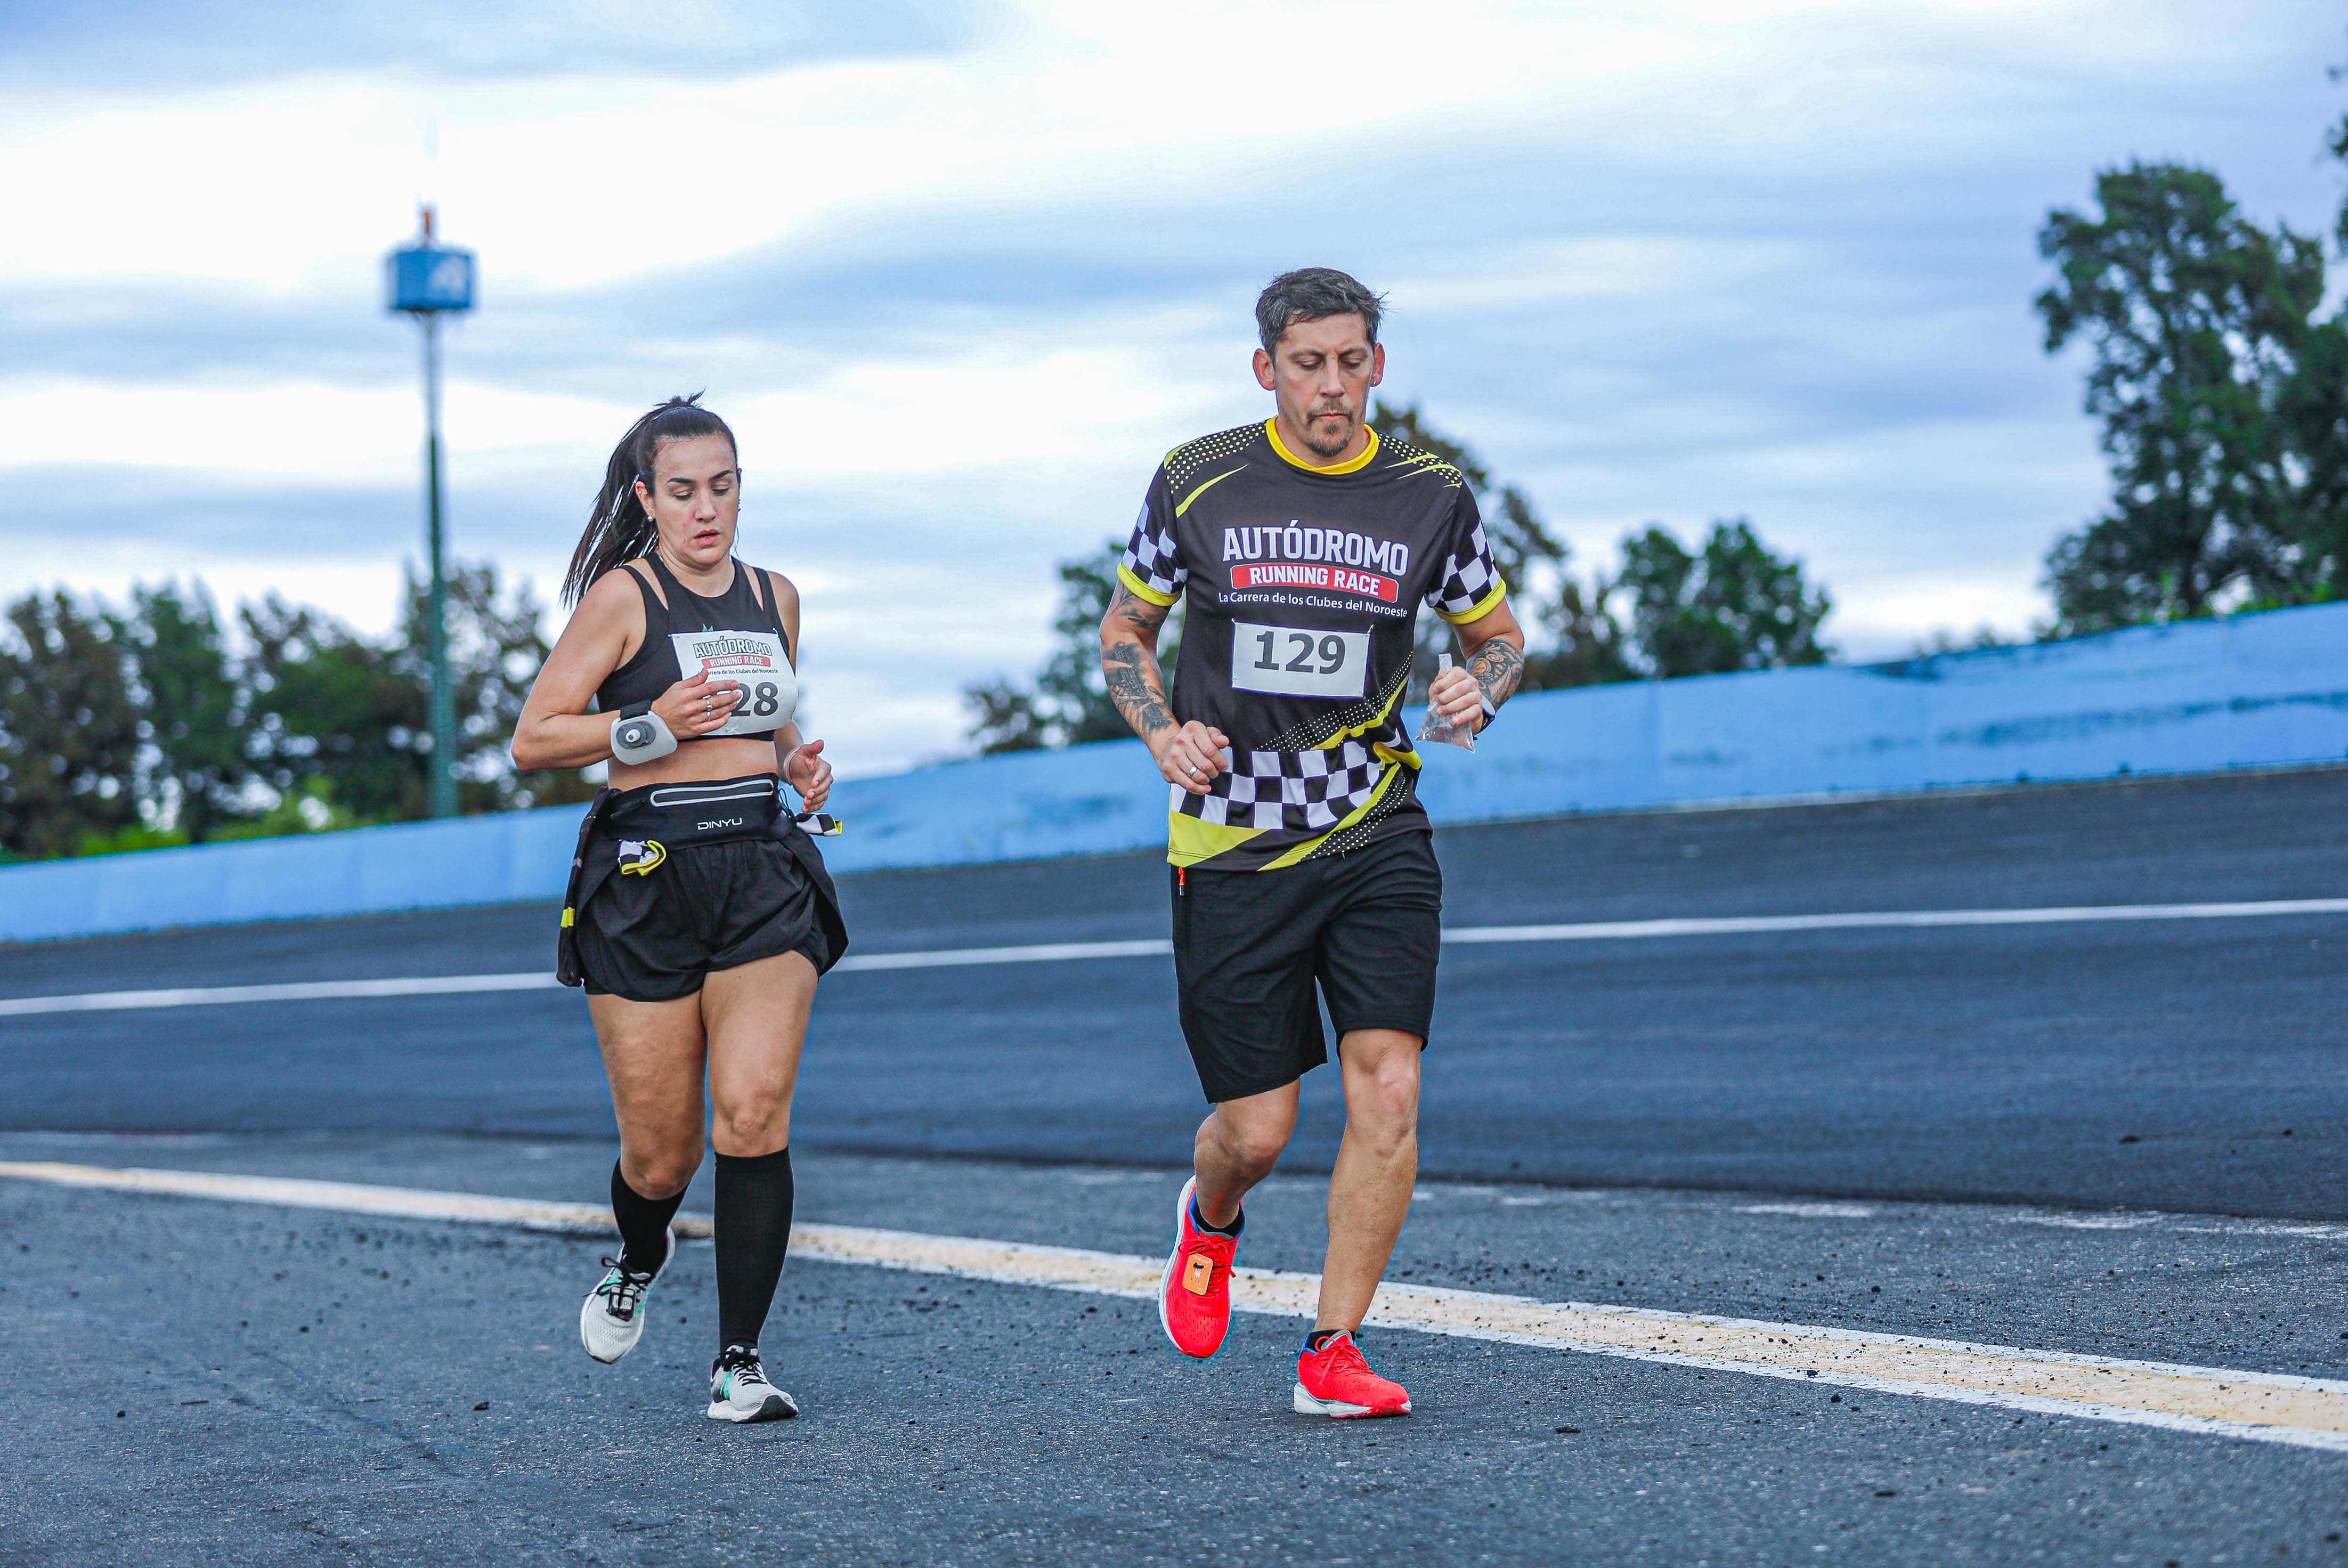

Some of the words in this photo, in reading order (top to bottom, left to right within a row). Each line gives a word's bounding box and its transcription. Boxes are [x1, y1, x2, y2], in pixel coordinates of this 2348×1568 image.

[1222, 519, 1409, 576] AUTÓDROMO
[1249, 566, 1328, 585] RUNNING
[1334, 571, 1380, 596] RACE
[1218, 592, 1228, 602] La
[1230, 592, 1269, 602] Carrera
[1272, 592, 1286, 603] de
[1288, 594, 1303, 605] los
[1306, 596, 1343, 608] Clubes
[1345, 599, 1362, 611] del
[1366, 602, 1407, 617] Noroeste
[693, 636, 773, 659] AUTÓDROMO
[1254, 631, 1346, 675] 129
[709, 656, 742, 667] RUNNING
[744, 656, 763, 665] RACE
[711, 682, 778, 717] 28
[697, 817, 742, 830] DINYU
